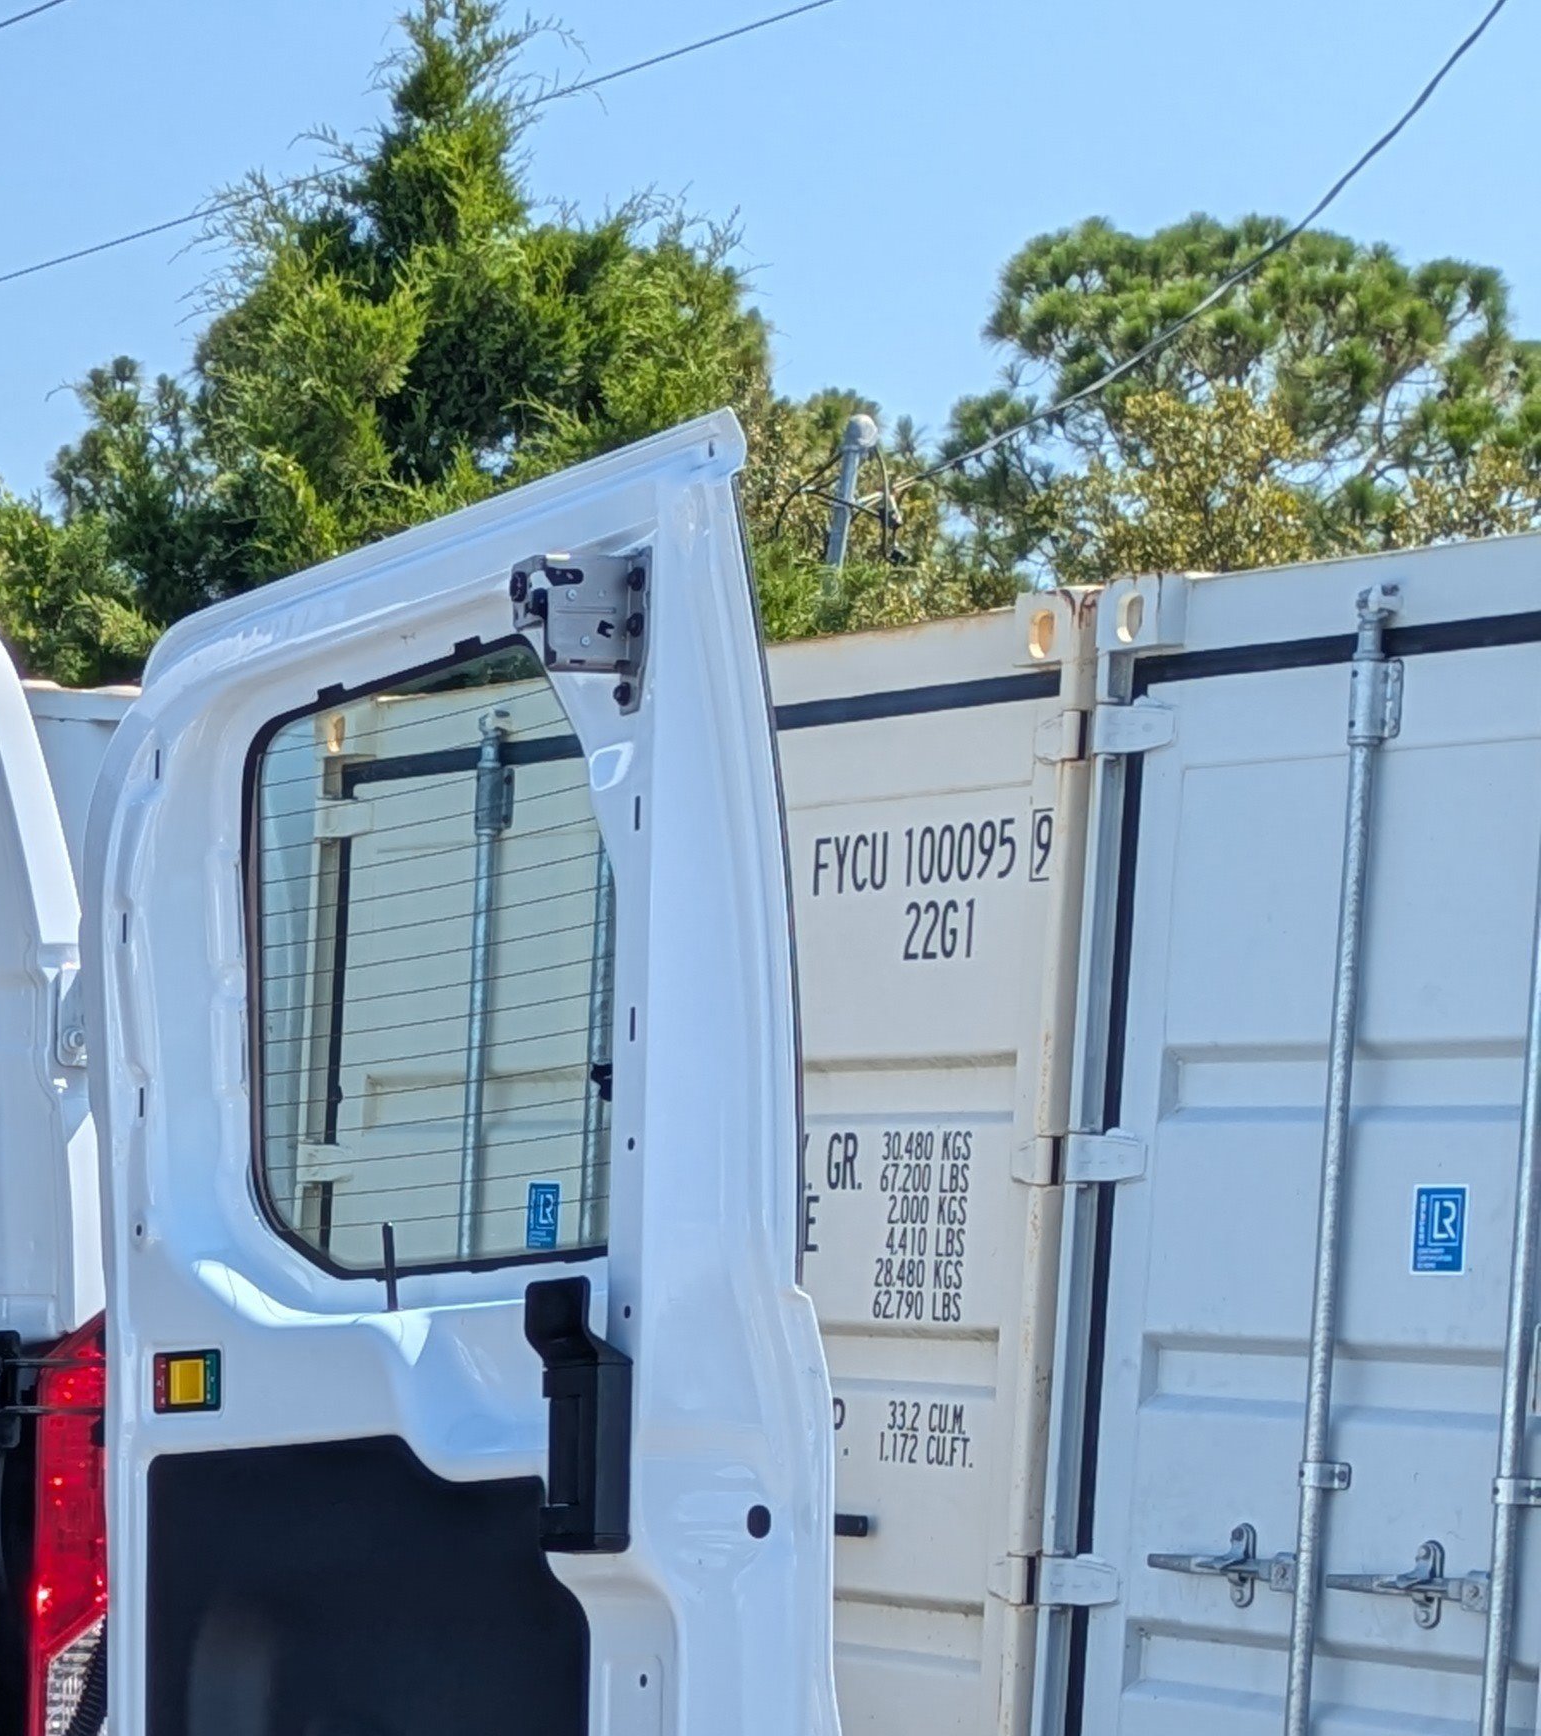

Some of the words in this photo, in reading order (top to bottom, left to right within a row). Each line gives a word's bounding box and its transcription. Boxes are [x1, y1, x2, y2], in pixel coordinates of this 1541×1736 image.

[813, 832, 888, 896] FYCU
[905, 818, 1016, 886] 100095
[1035, 813, 1053, 874] 9
[903, 899, 975, 960] 22G1
[882, 1131, 934, 1160] 30.480
[941, 1131, 972, 1161] KGS
[827, 1133, 862, 1190] GR.
[880, 1163, 931, 1193] 67.200
[939, 1163, 969, 1193] LBS
[937, 1196, 967, 1225] KGS
[935, 1227, 965, 1257] LBS
[874, 1258, 925, 1288] 28.480
[934, 1260, 963, 1289] KGS
[932, 1292, 961, 1322] LBS
[880, 1431, 918, 1463] 1.172
